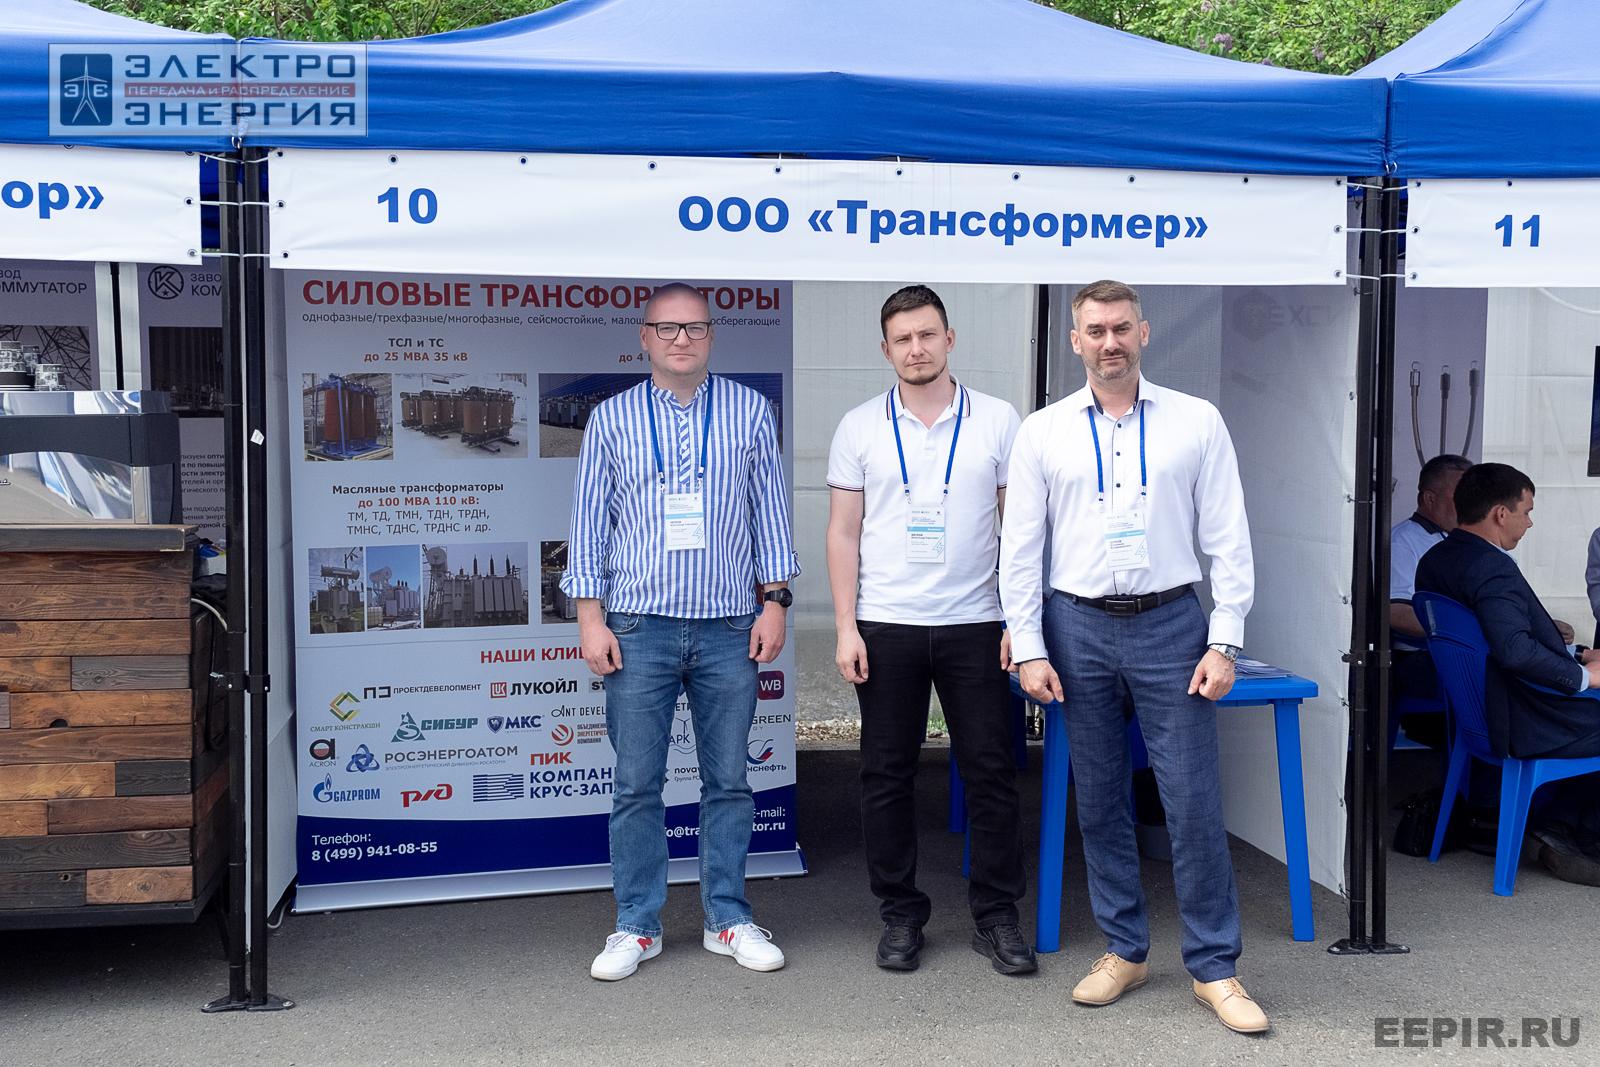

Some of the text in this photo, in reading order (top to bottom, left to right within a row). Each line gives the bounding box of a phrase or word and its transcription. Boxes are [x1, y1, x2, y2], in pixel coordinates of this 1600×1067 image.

[1, 181, 104, 219] ор»
[378, 187, 438, 224] 10
[678, 196, 1209, 248] ООО «Трансформер»
[1494, 214, 1541, 247] 11
[0, 281, 87, 294] ММУТАТОР
[303, 279, 471, 307] СИЛОВЫЕ
[302, 312, 523, 326] однофазные/трехфазные/многофазные,
[528, 314, 607, 327] сейсмостойкие,
[388, 337, 444, 348] ТСЛ и ТС
[364, 352, 468, 363] до 25 МВА 35 кВ
[619, 353, 633, 363] до
[332, 483, 504, 495] Масляные трансформаторы
[358, 496, 480, 509] до 100 МВА 110 кВ:
[348, 508, 490, 522] ТМ, ТД, ТМН, ТДН, ТРДН,
[347, 525, 381, 536] ТМНС,
[386, 524, 419, 535] ТДНС,
[424, 523, 460, 534] ТРДНС
[475, 523, 491, 534] др.
[480, 648, 536, 664] НАШИ
[393, 684, 482, 695] ПРОЕКТДЕВЕЛОПМЕНТ
[510, 678, 577, 695] ЛУКОЙЛ
[760, 680, 781, 691] WB
[310, 721, 334, 732] СМАРТ
[421, 717, 478, 731] СИБУР
[505, 715, 542, 730] МКС
[385, 745, 518, 763] РОСЭНЕРГОАТОМ
[530, 752, 573, 766] ПИК
[309, 760, 336, 768] ACRON
[333, 788, 380, 802] GAZPROM
[530, 782, 616, 799] КРУС-ЗАП
[311, 833, 372, 846] Телефон:
[311, 841, 438, 863] 8 (499) 941-08-55
